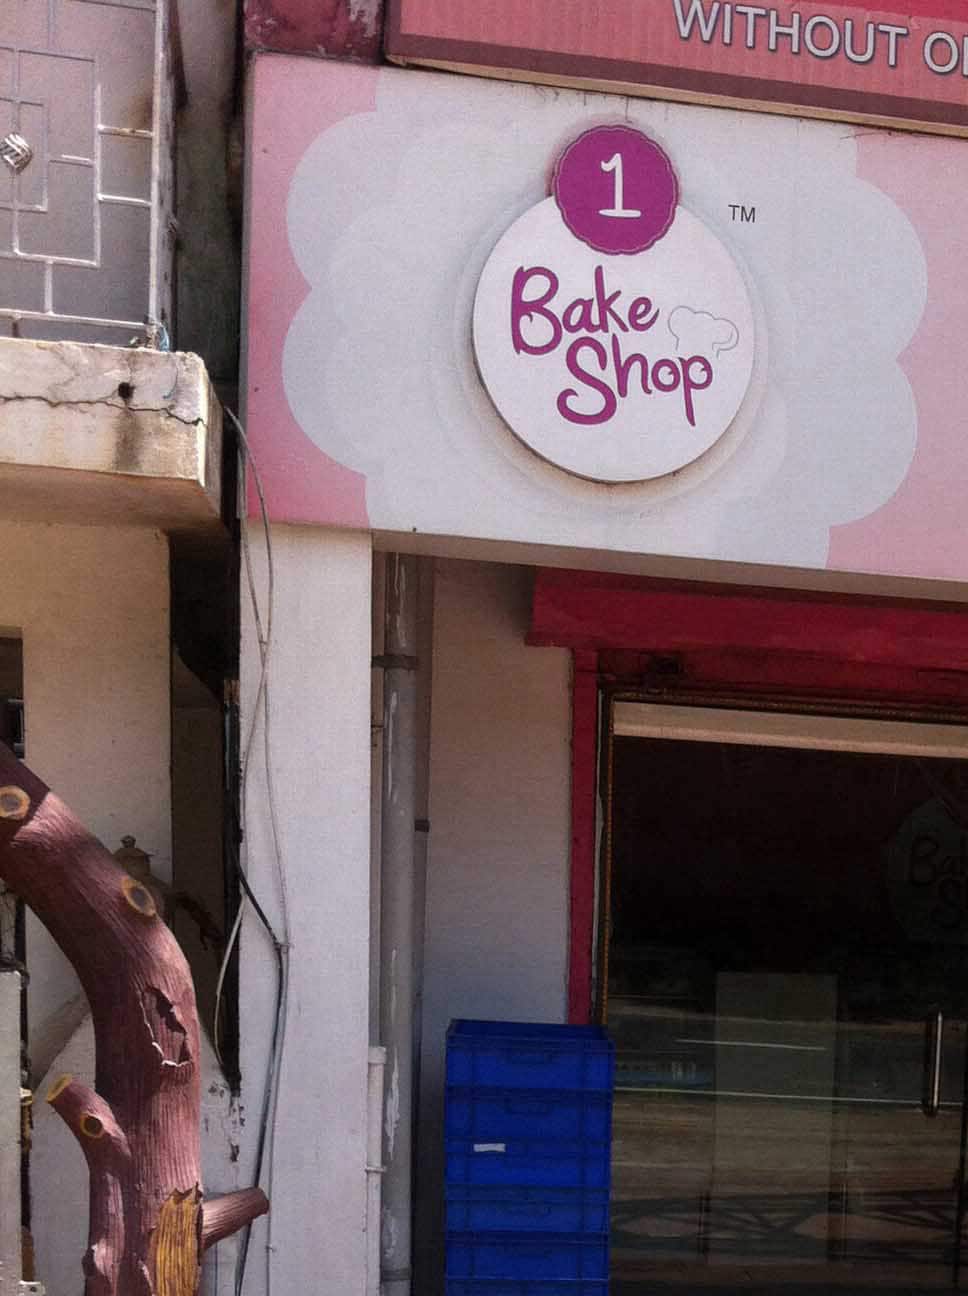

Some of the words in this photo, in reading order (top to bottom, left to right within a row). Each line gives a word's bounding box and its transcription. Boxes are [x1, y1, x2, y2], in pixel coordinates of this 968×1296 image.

[672, 0, 909, 67] WITHOUT
[598, 152, 642, 219] 1
[510, 264, 660, 355] Bake
[556, 333, 714, 427] Shop
